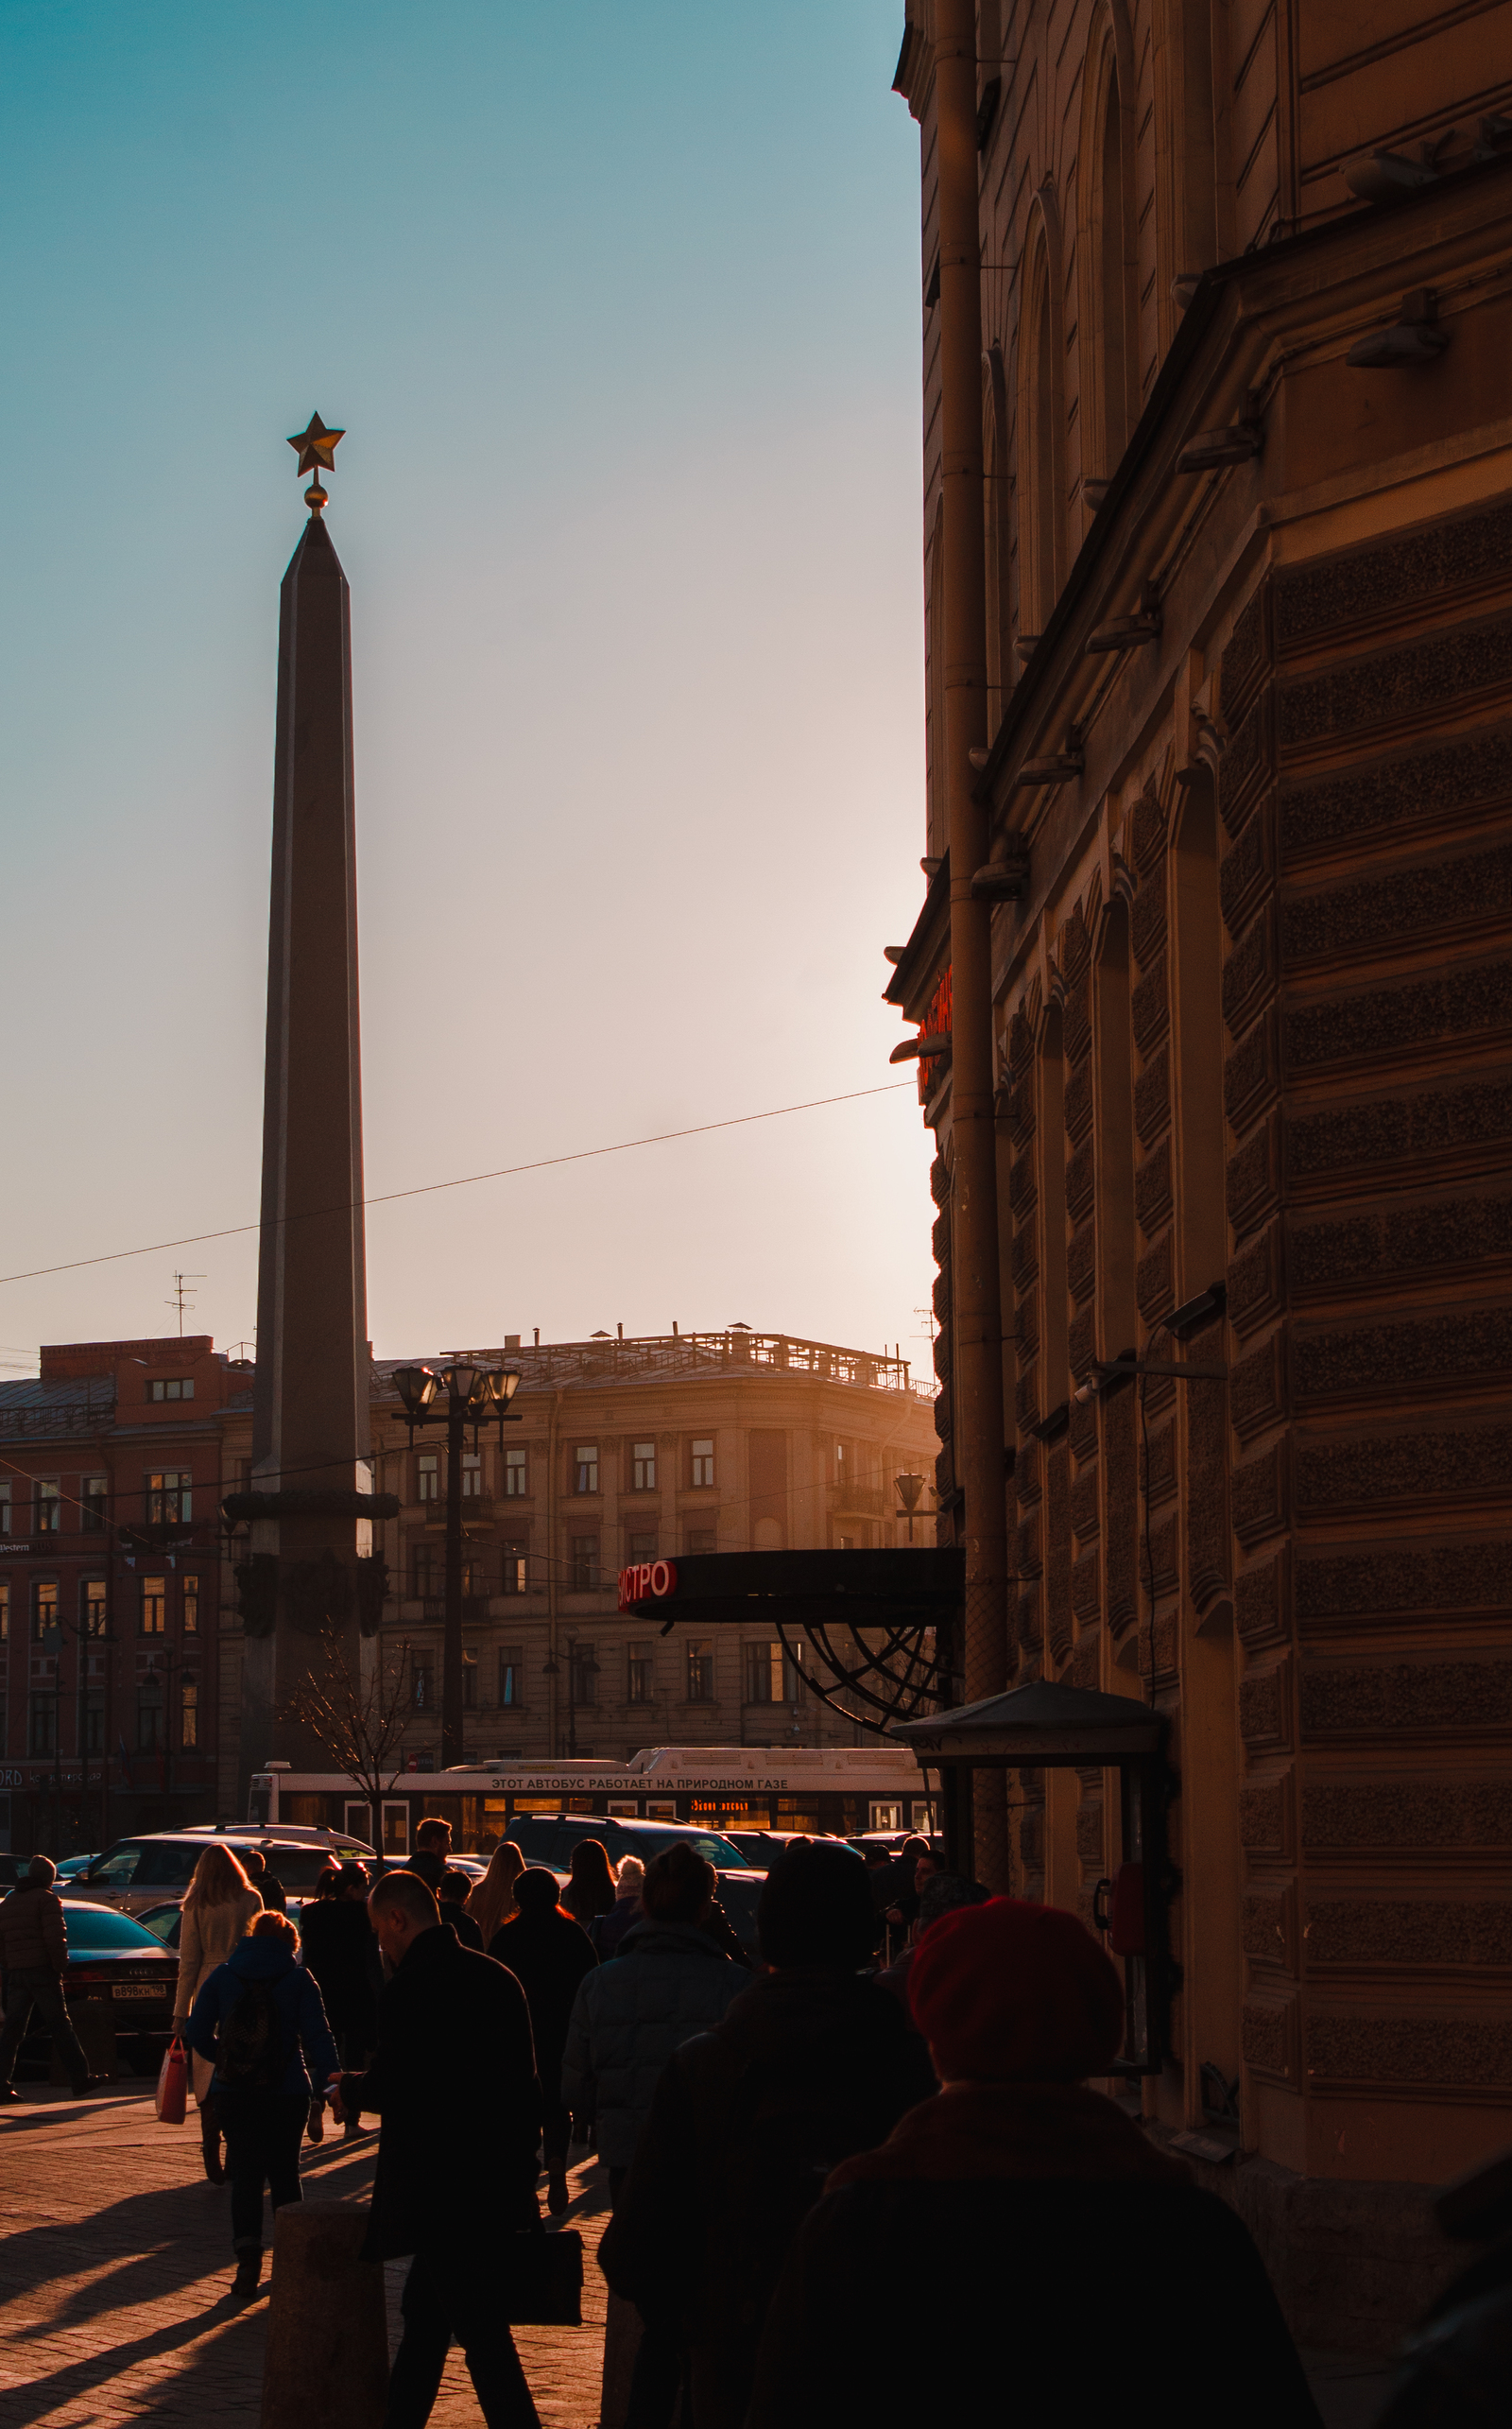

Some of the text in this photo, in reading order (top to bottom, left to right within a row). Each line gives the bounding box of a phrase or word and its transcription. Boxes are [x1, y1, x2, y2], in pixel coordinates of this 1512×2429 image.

[491, 1779, 788, 1790] ЭТОТ АВТОБУС РАБОТАЕТ НА ПРИРОДНОМ ГАЗЕ
